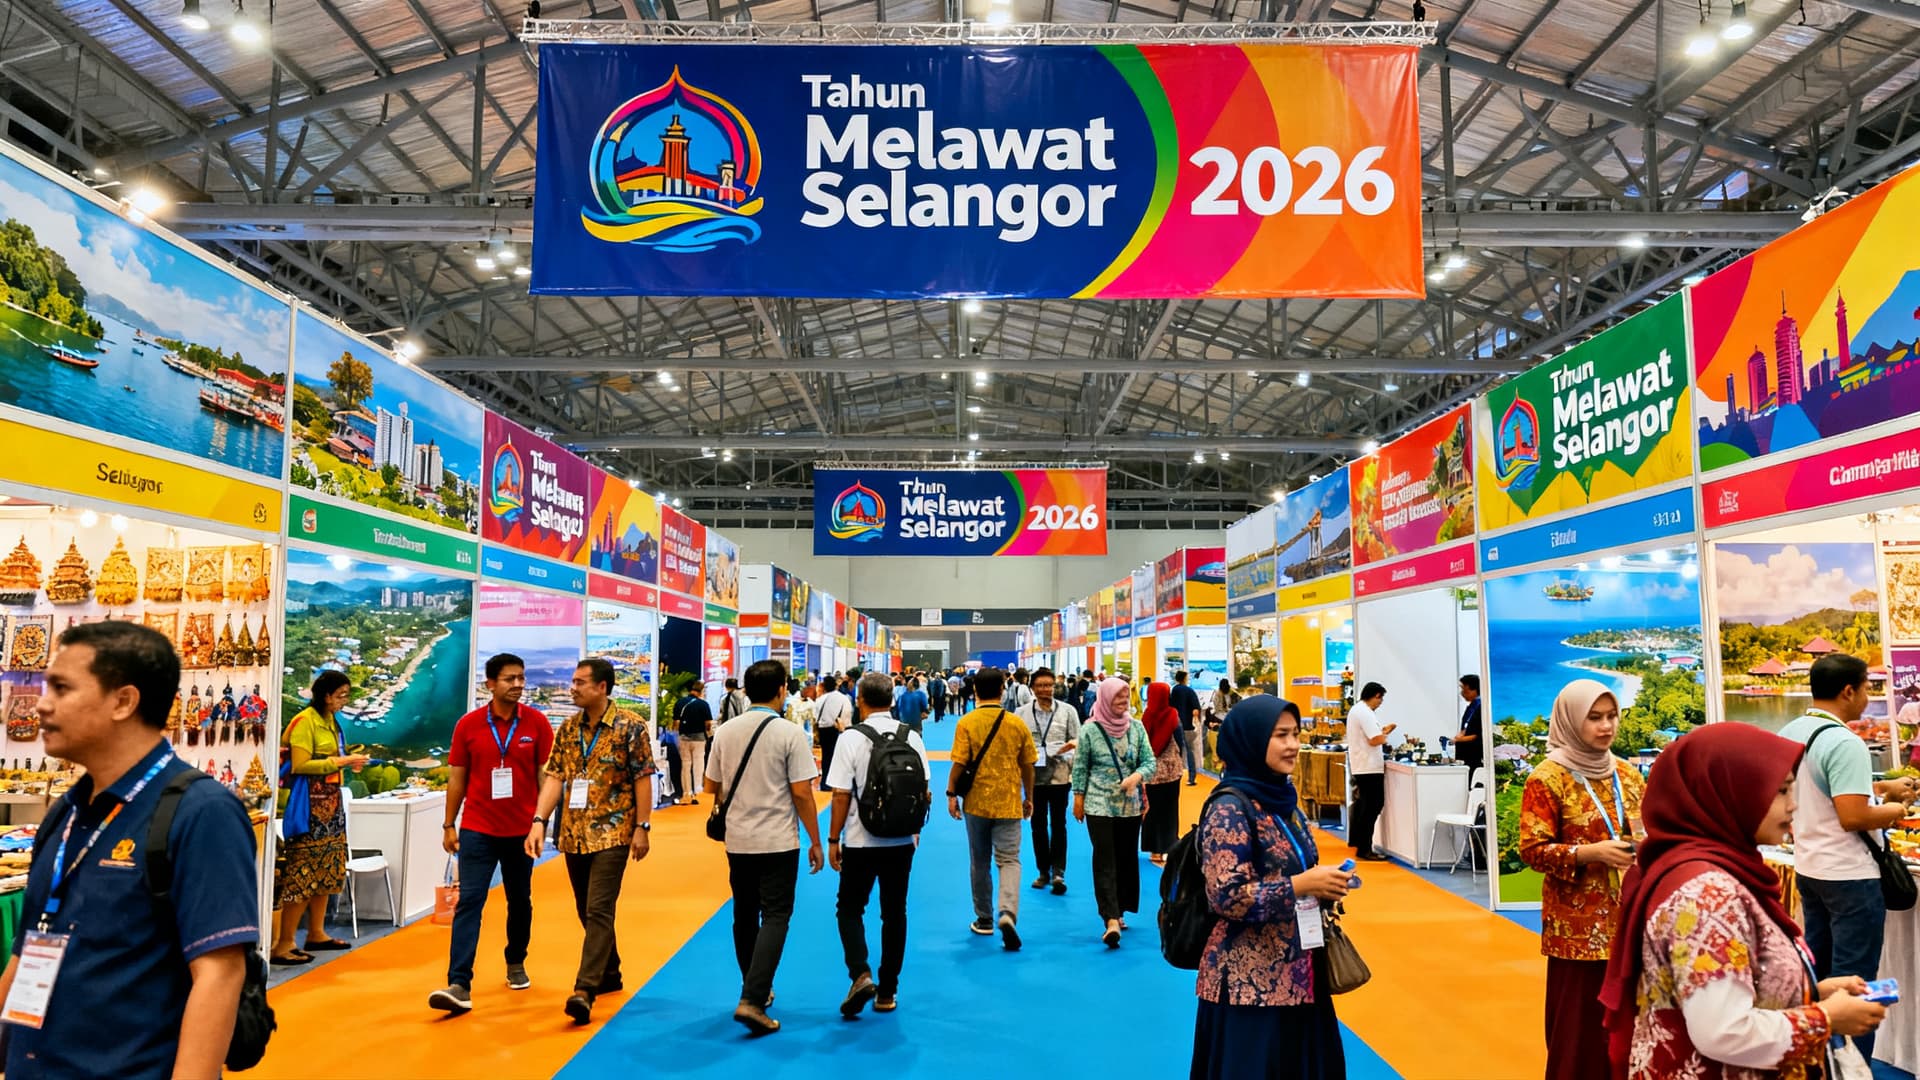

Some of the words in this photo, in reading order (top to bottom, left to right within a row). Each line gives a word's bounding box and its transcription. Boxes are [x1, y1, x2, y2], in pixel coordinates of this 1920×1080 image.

[801, 74, 926, 109] Tahun
[806, 111, 1117, 171] Melawat
[800, 170, 1118, 243] Selangor
[1189, 146, 1395, 216] 2026
[1553, 347, 1674, 434] Melawat
[1553, 396, 1674, 470] Selangor
[899, 516, 1007, 542] Selangor
[900, 493, 1006, 517] Melawat
[1027, 503, 1099, 531] 2026
